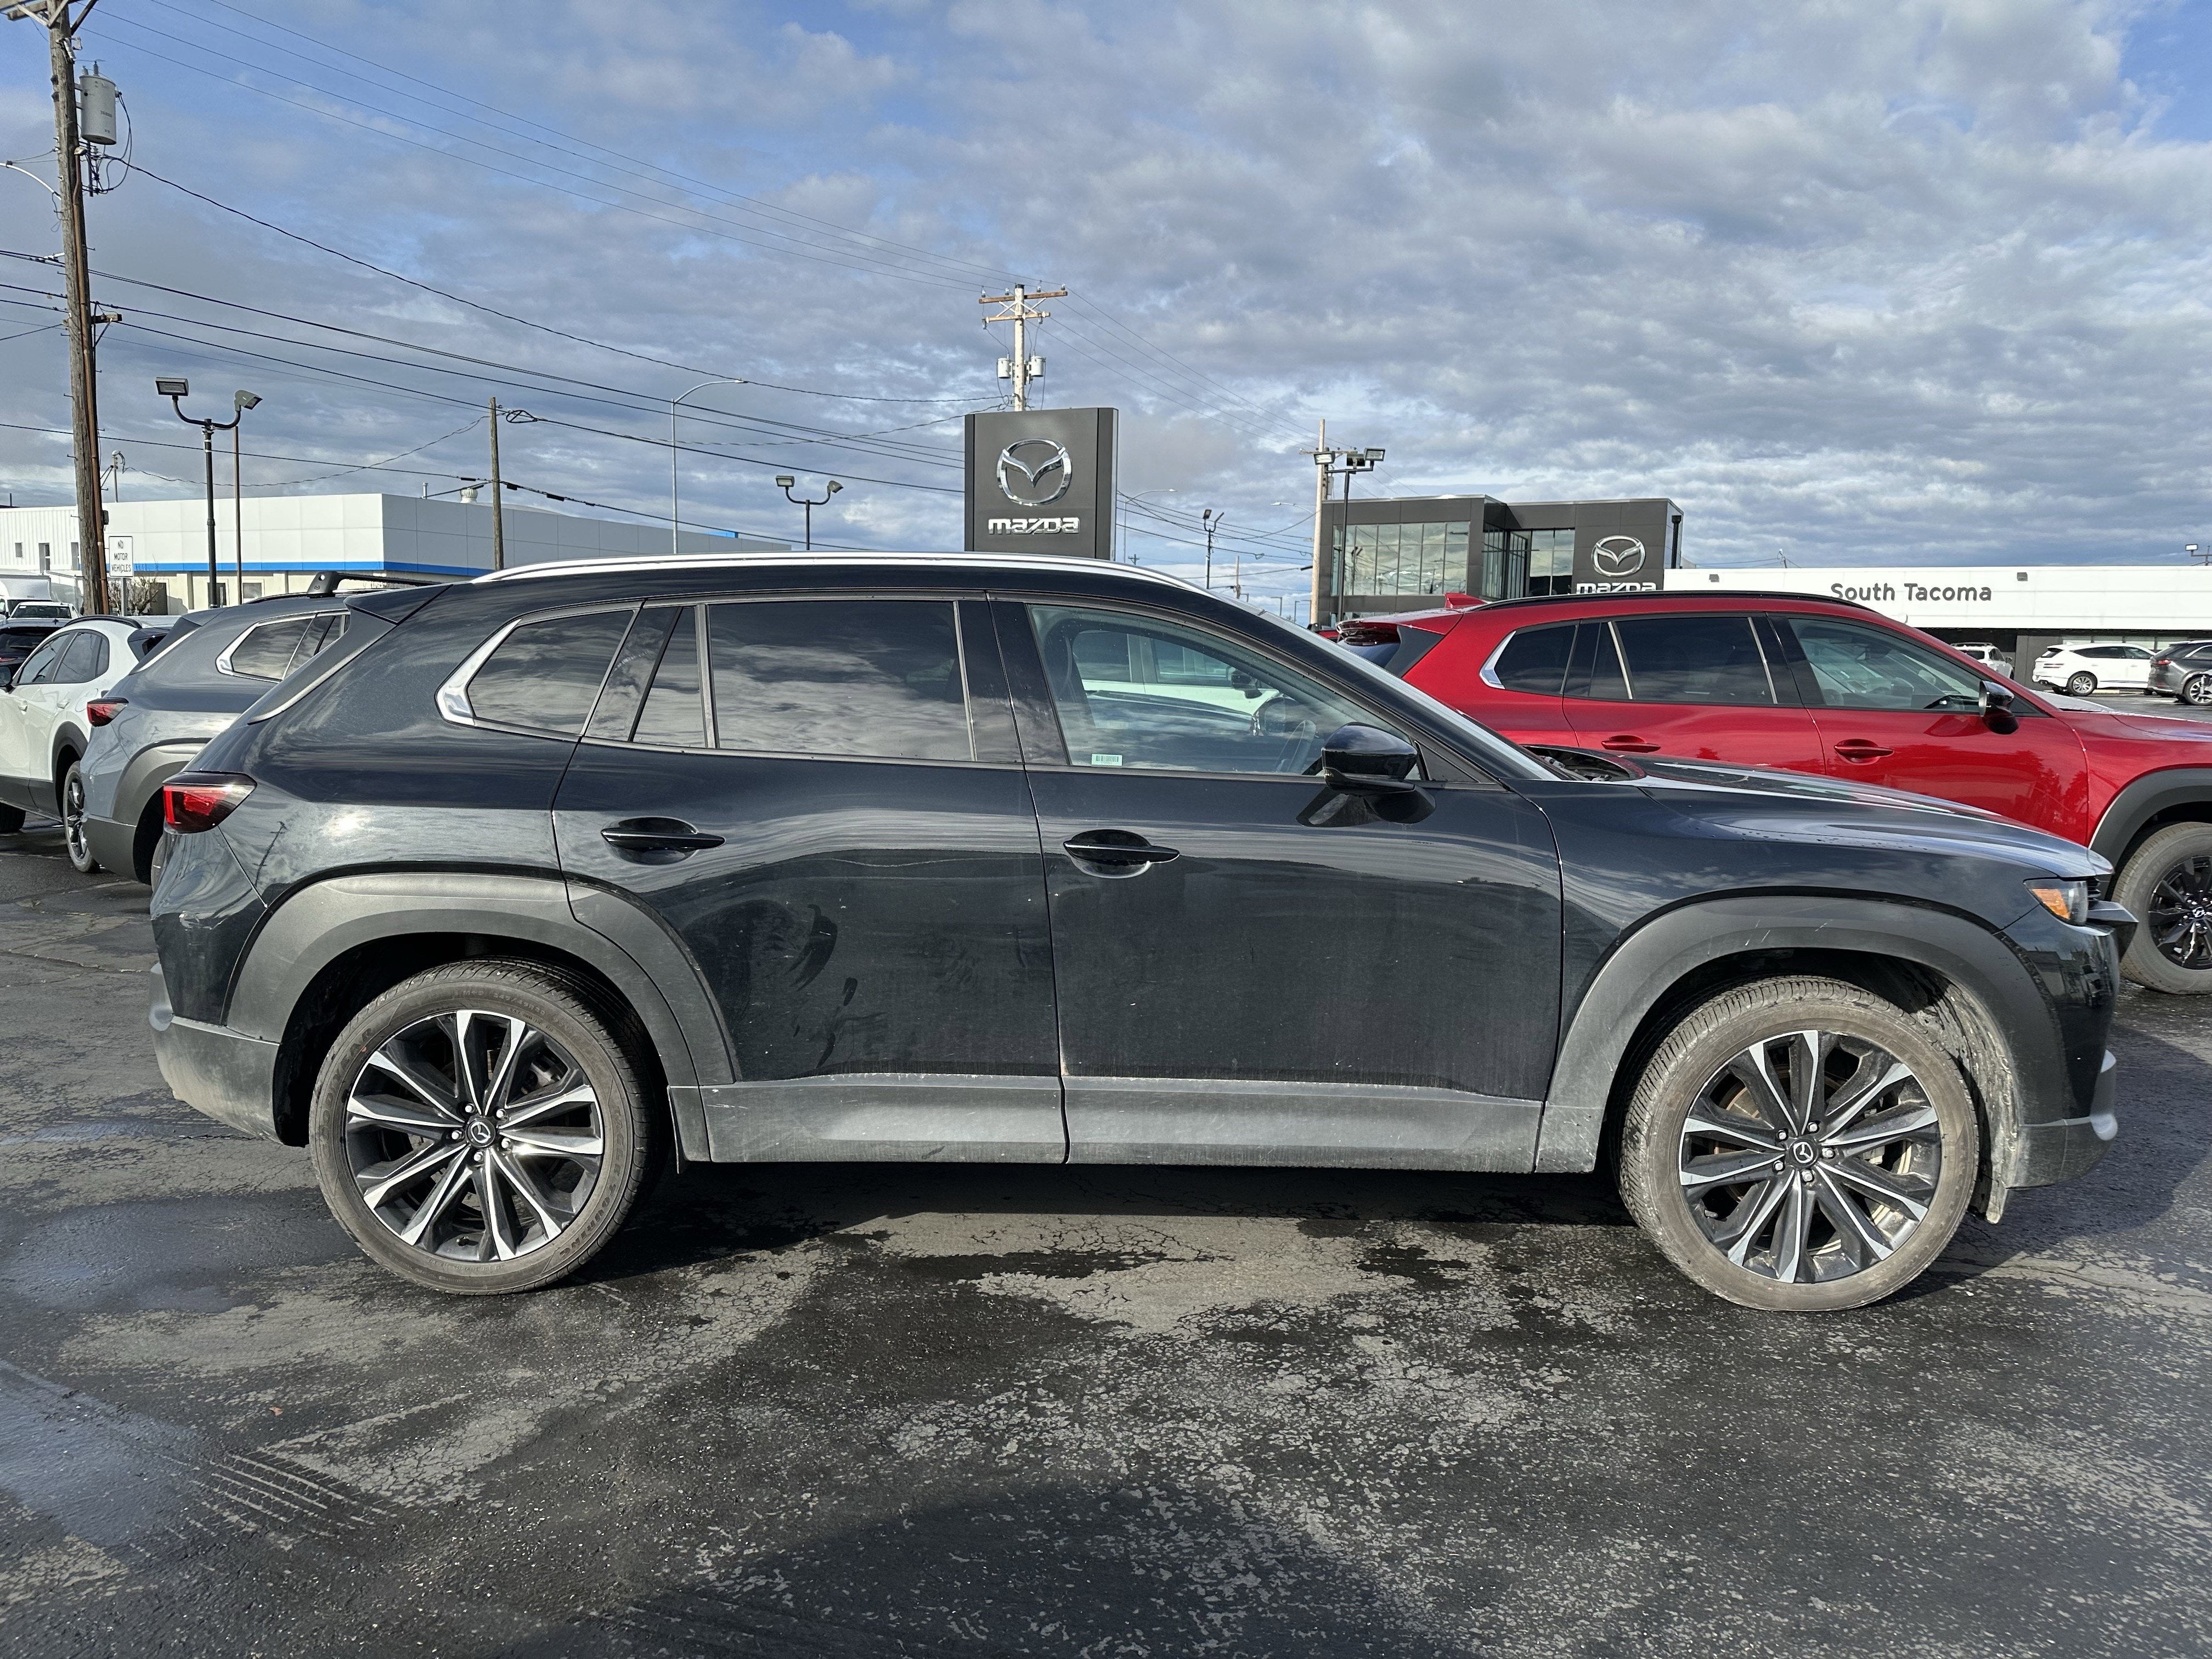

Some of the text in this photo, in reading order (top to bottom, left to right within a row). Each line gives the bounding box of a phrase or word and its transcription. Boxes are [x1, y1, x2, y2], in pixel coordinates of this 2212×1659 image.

[117, 540, 123, 549] NO
[111, 564, 131, 572] VEHICLES
[1831, 583, 1991, 601] South Tacoma
